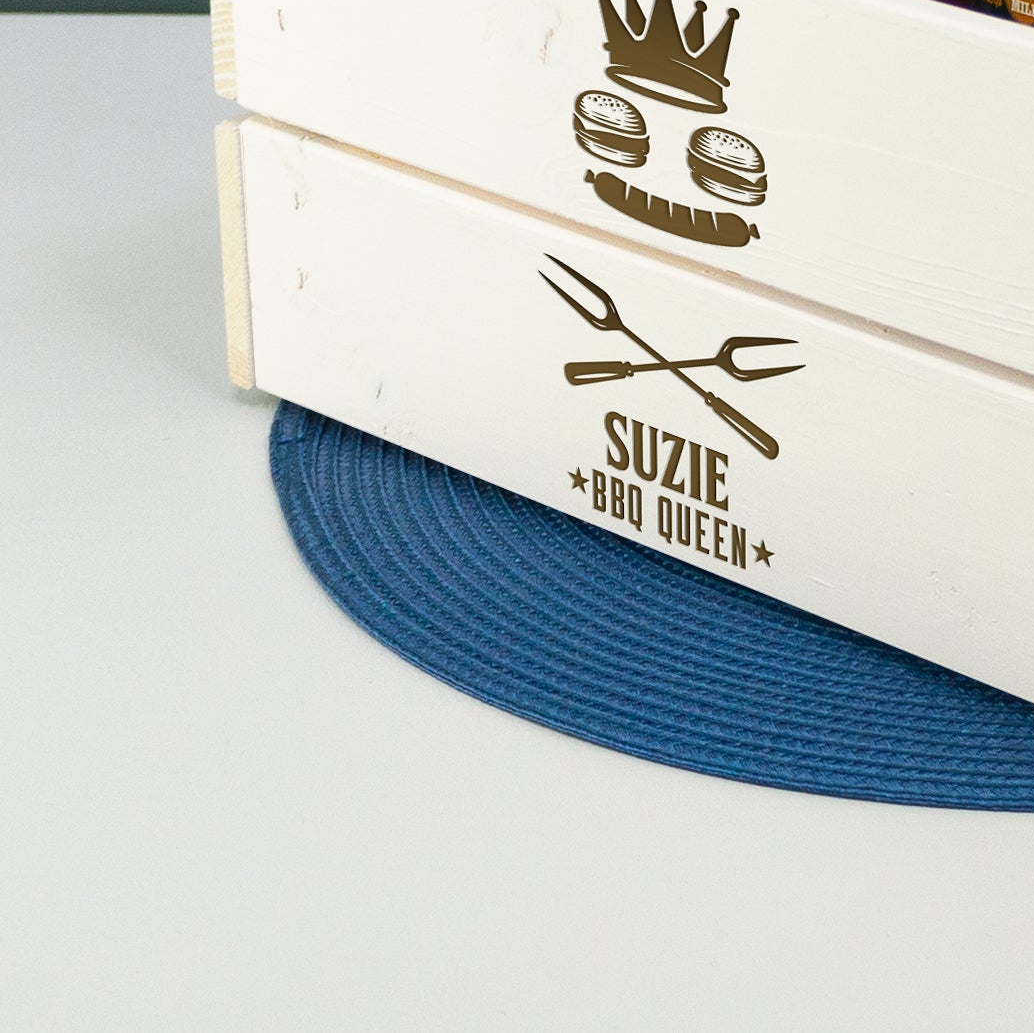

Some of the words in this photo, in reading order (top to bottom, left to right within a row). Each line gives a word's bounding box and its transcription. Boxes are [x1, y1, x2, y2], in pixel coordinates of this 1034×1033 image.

[603, 411, 729, 512] SUZIE
[592, 468, 643, 533] BBQ
[657, 495, 747, 570] QUEEN
